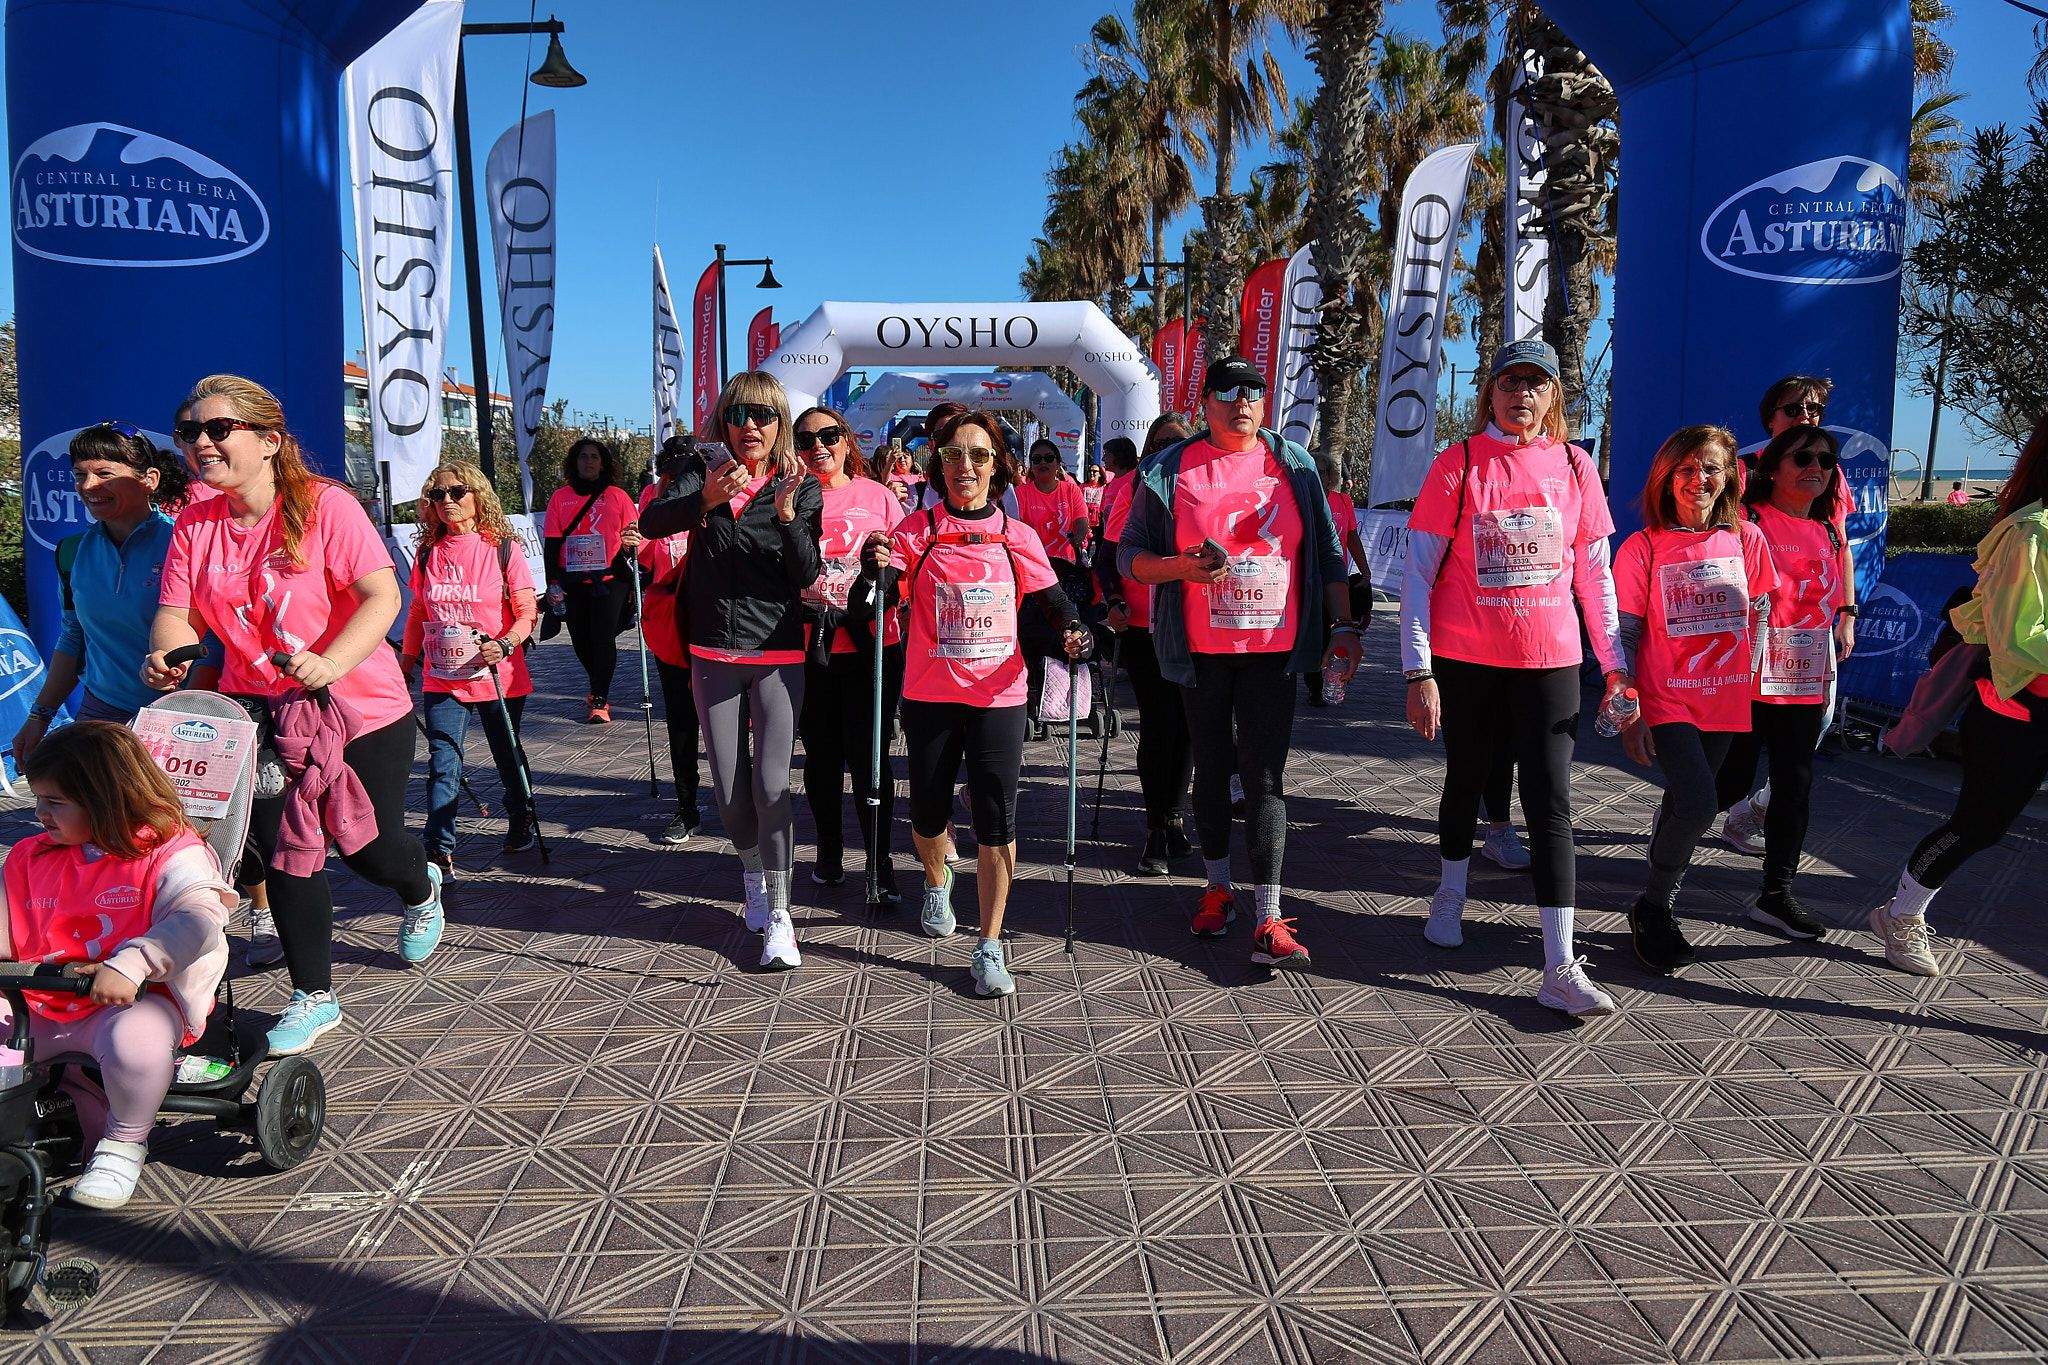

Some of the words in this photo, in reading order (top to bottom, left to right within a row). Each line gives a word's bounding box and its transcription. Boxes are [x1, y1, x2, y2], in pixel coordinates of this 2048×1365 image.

[36, 172, 119, 186] CENTRAL
[131, 175, 236, 201] LECHERA
[17, 177, 249, 244] ASTURIANA
[1768, 201, 1854, 216] CENTRAL
[368, 87, 437, 437] OYSHO
[501, 177, 554, 437] OYSHO
[1385, 194, 1450, 438] OYSHO
[877, 316, 1038, 348] OYSHO
[699, 294, 713, 387] Santander
[780, 353, 829, 365] OYSHO
[1084, 351, 1132, 362] OYSHO
[1163, 342, 1175, 412] Santander
[1184, 335, 1206, 408] Santander
[1503, 520, 1534, 528] ASTURIANA
[1506, 542, 1538, 556] 016
[1769, 544, 1800, 552] OYSHO
[820, 581, 845, 593] 016
[1233, 588, 1264, 601] 016
[1694, 591, 1727, 605] 016
[1515, 597, 1524, 607] DE
[1527, 597, 1537, 606] LA
[964, 616, 993, 629] 016
[1676, 624, 1705, 632] OYSHO
[441, 647, 464, 657] 016
[1785, 658, 1811, 670] 016
[1667, 678, 1701, 689] CARRERA
[1702, 678, 1711, 687] DE
[1714, 676, 1723, 686] LA
[1702, 687, 1717, 696] 2025
[175, 727, 215, 740] ASTURIANA
[165, 757, 208, 776] 016
[185, 802, 216, 812] Santander
